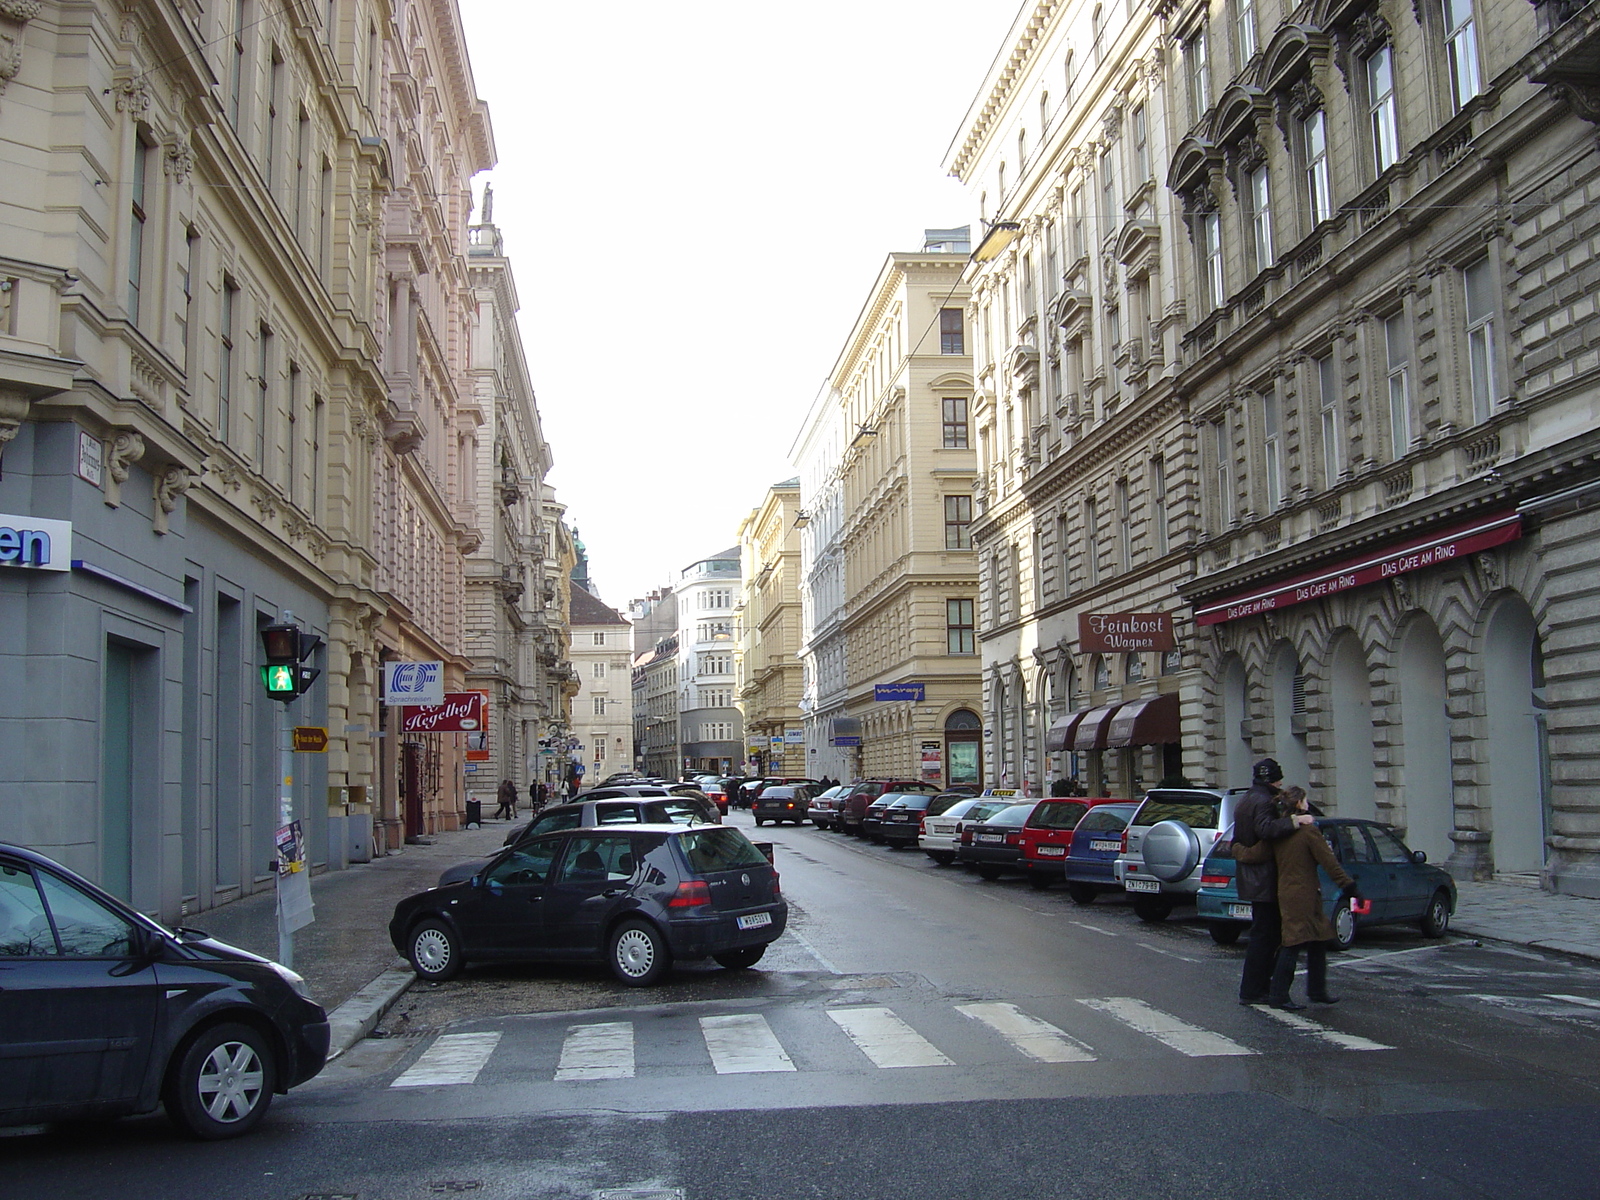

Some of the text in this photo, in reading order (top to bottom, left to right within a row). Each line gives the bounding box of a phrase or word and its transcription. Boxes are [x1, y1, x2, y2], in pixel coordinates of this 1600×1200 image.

[1381, 545, 1456, 577] DAS CAFE AM RING
[1296, 575, 1356, 601] DAS CAFE AM RING
[1227, 607, 1238, 619] DAS
[1261, 598, 1276, 610] RING
[1088, 615, 1164, 634] Feinkost
[1103, 633, 1153, 651] Wagner
[389, 695, 432, 703] Sprachreisen
[405, 695, 478, 731] Hegelhof
